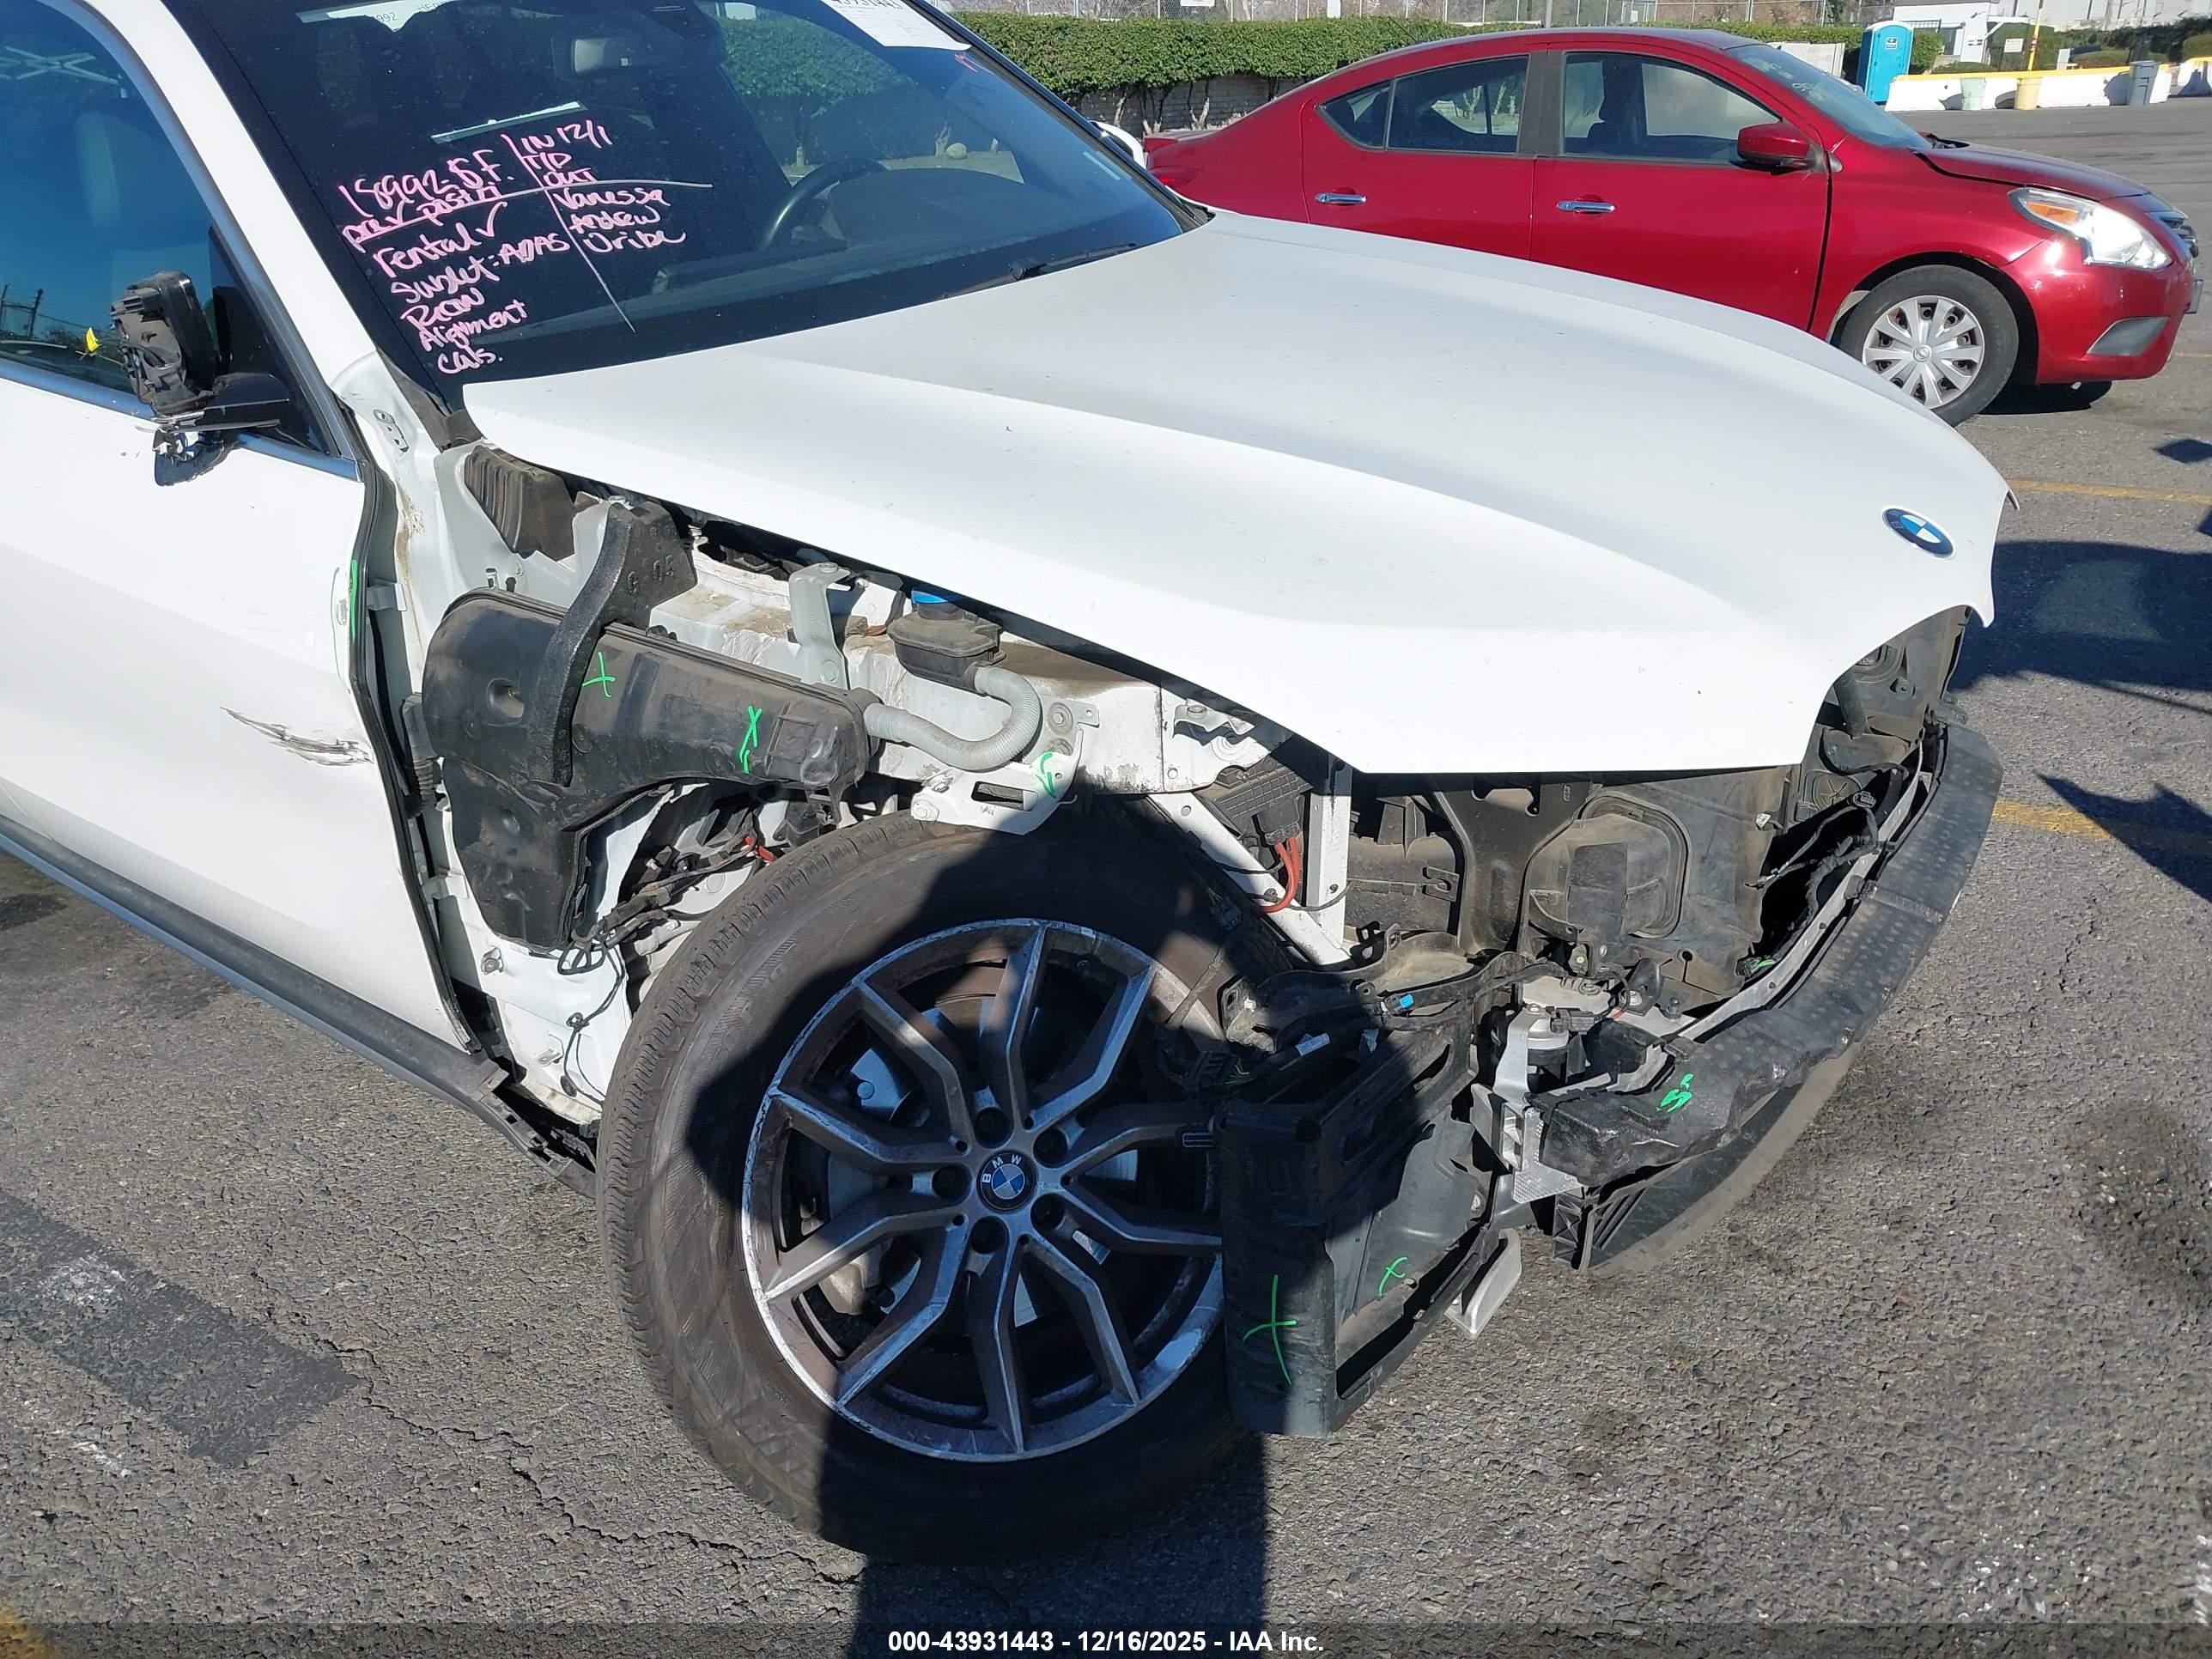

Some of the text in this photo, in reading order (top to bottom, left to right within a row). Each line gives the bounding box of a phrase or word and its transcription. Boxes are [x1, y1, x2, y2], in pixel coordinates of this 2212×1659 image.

[520, 119, 613, 154] IN 12/1
[543, 167, 596, 187] OUT
[552, 187, 672, 210] Vanessa
[568, 204, 661, 234] Andrew
[496, 233, 571, 265] ADAS
[981, 1154, 1022, 1183] BMW
